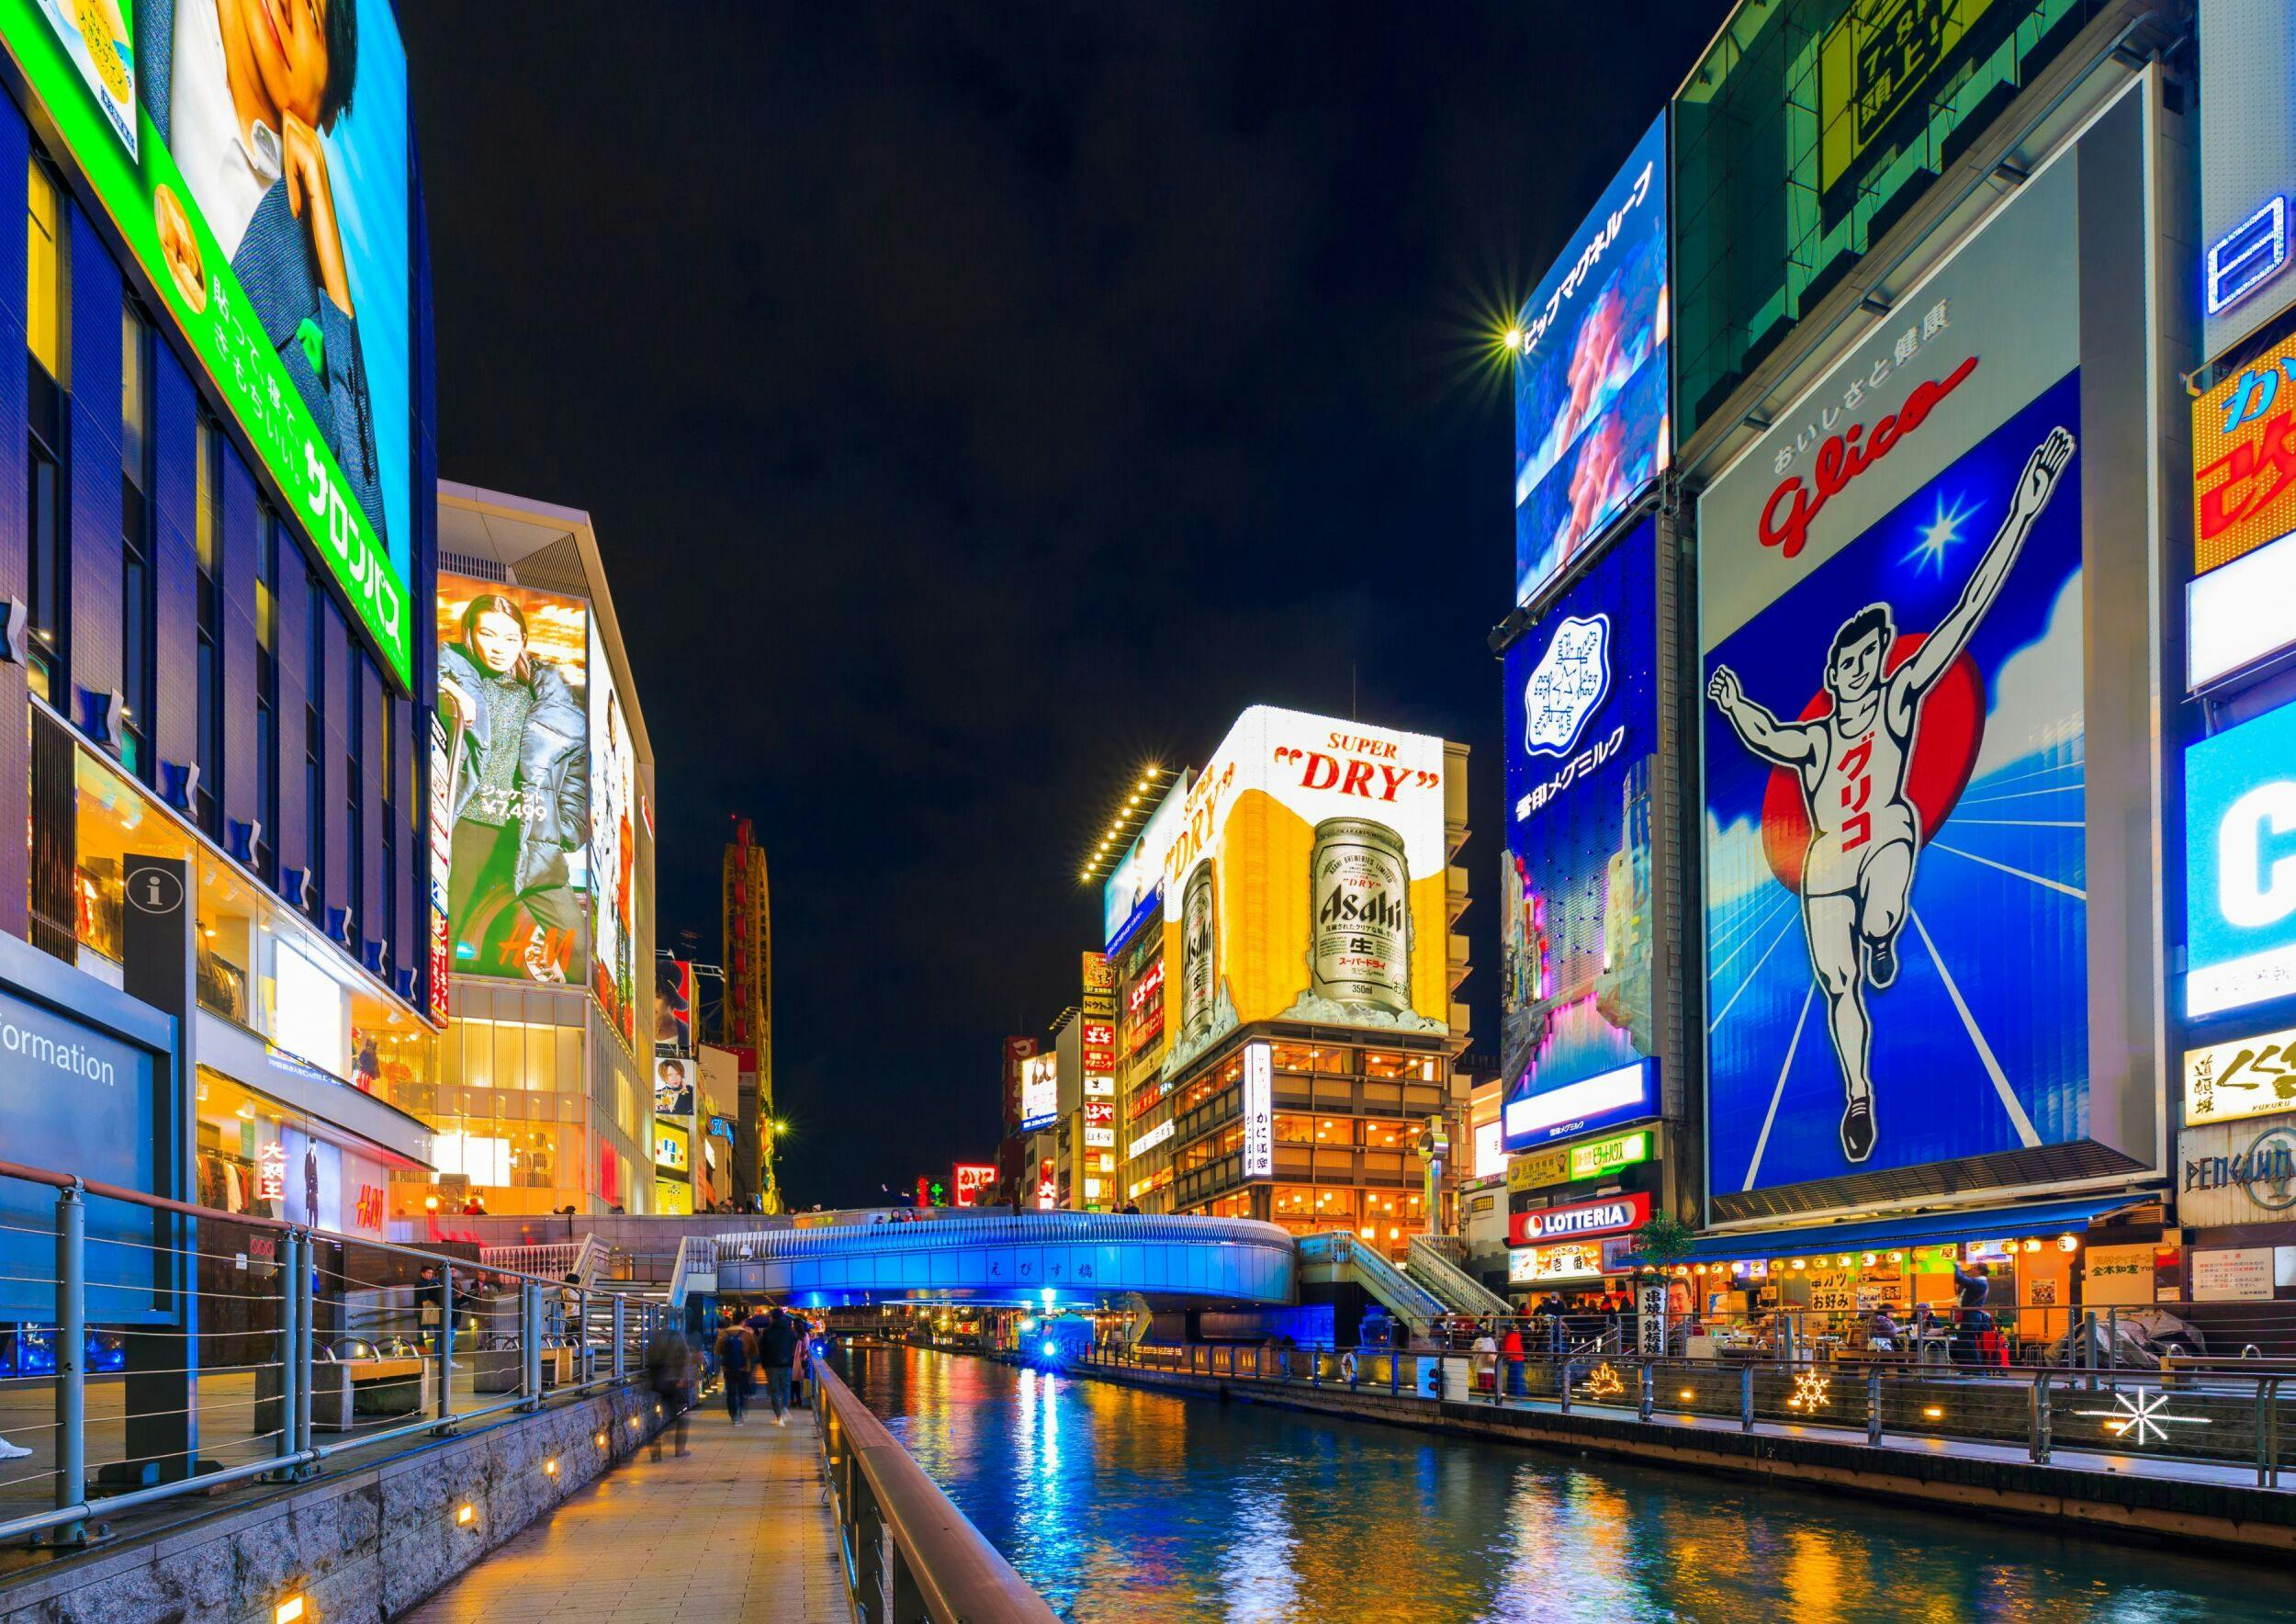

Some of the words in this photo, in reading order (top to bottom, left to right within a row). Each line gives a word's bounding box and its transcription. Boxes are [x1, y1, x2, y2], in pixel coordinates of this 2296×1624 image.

[1523, 161, 1653, 356] ピップマグネループ
[211, 274, 299, 448] 貼って、寝て、
[213, 320, 300, 487] きもちいい。
[1773, 296, 1952, 476] おいしさと健康
[1759, 355, 1981, 559] Glico
[304, 437, 403, 654] サロンパス
[1327, 731, 1398, 760] SUPER
[1515, 724, 1626, 823] 雪印メグミルク
[1837, 729, 1875, 853] グリコ
[482, 784, 545, 806] ジャケット
[482, 797, 548, 822] ¥7,499
[1320, 884, 1401, 932] Asahi
[1339, 957, 1386, 970] スーパードライ
[1350, 937, 1374, 955] 生
[1352, 984, 1373, 995] 350ml
[0, 1019, 115, 1087] ormation
[2193, 1054, 2214, 1115] 道頓堀
[2251, 1100, 2290, 1112] KUKURU
[1549, 1121, 1584, 1137] 雪印メグミルク
[1544, 1204, 1624, 1234] LOTTERIA
[2092, 1264, 2139, 1277] 金本知憲
[1813, 1292, 1849, 1310] お好み
